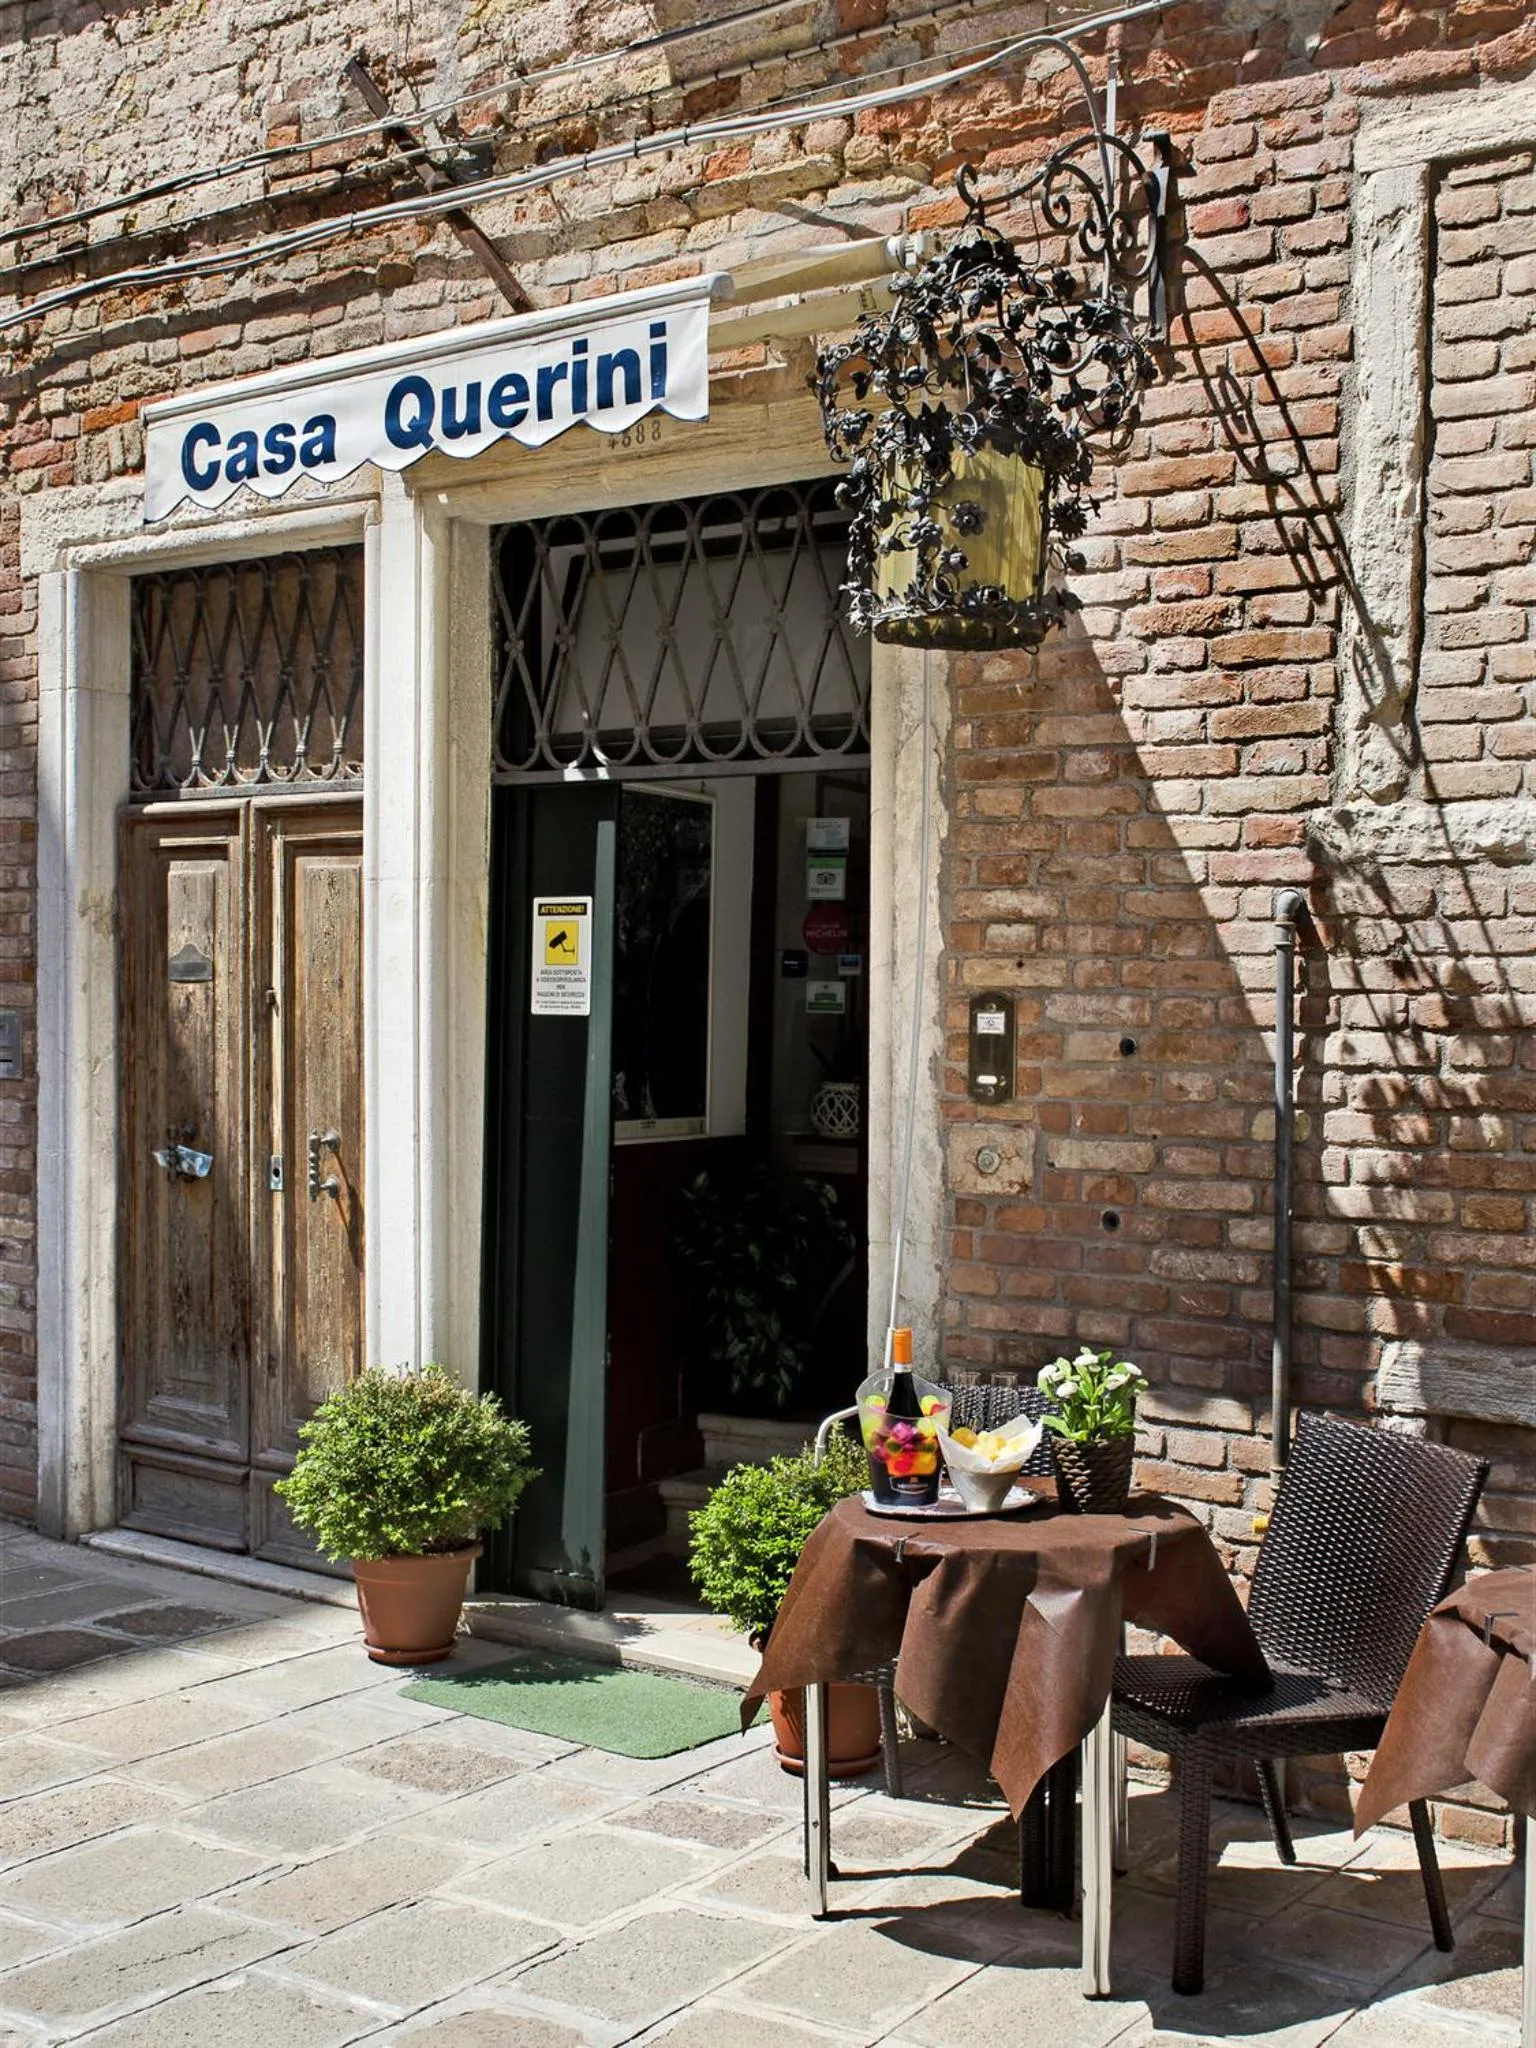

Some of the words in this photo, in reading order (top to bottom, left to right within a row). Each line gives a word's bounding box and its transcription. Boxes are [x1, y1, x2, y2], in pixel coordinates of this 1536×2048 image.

[181, 413, 337, 491] Casa
[384, 321, 668, 451] Querini
[805, 928, 848, 939] MICHELIN
